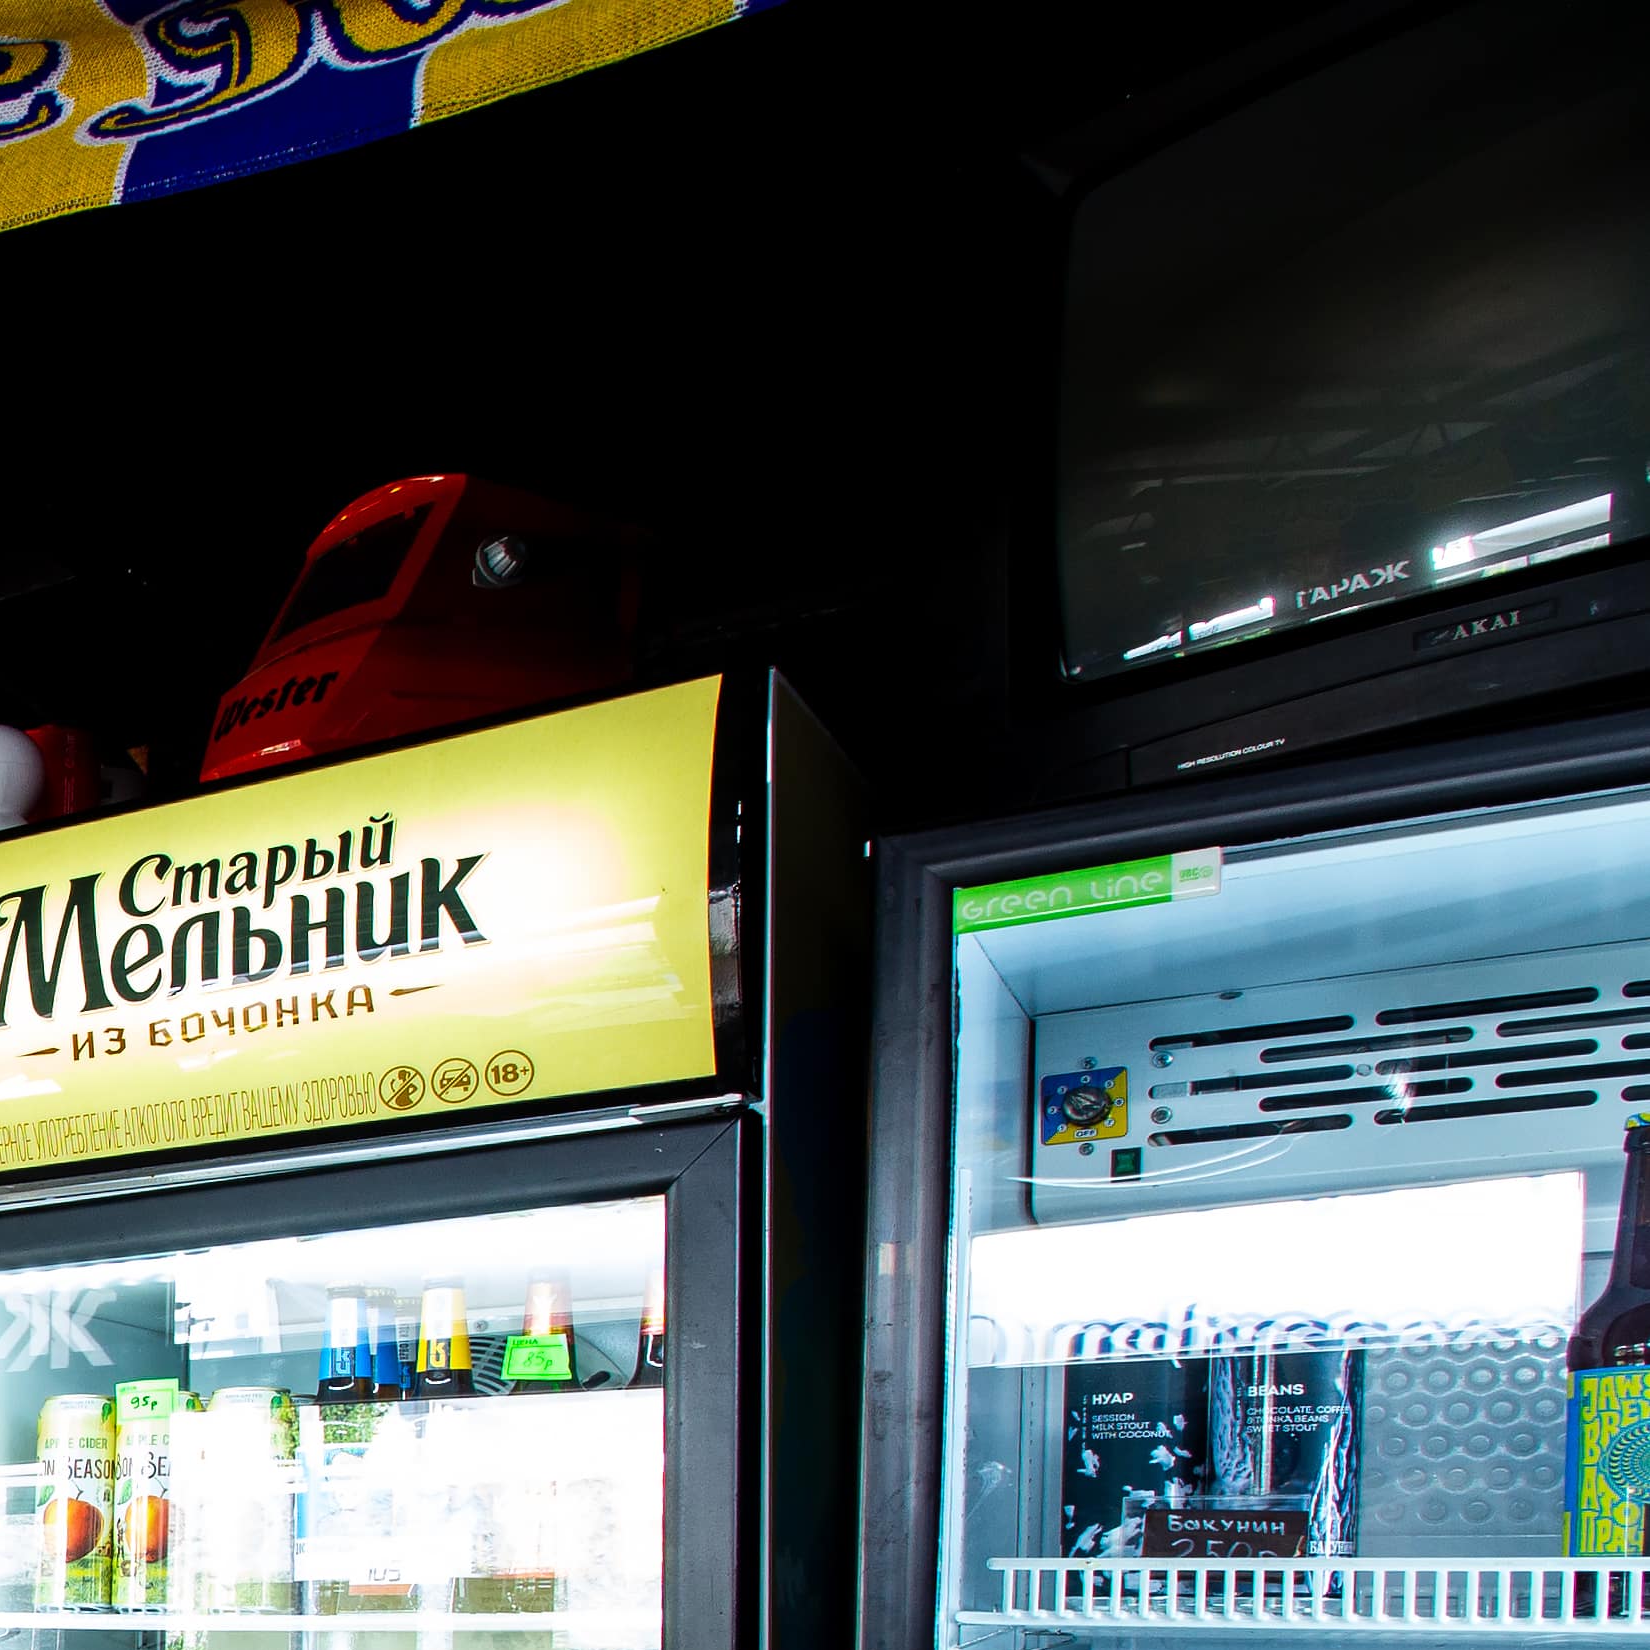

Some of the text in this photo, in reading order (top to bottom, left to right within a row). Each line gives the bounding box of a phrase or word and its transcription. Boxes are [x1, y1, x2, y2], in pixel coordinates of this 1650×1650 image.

[1451, 609, 1521, 640] AKAI
[213, 665, 340, 744] Wester
[1196, 748, 1242, 766] RESOLUTION
[1242, 740, 1274, 755] COLOUR
[1274, 738, 1286, 746] TV
[119, 811, 398, 920] Старый
[961, 885, 1072, 921] Green
[71, 983, 376, 1064] ИЗ БОЧОНКА
[490, 1062, 531, 1087] 18+
[32, 1106, 121, 1160] УПОТРЕБЛЕНИЕ
[121, 1096, 189, 1148] АЛКОГОЛЯ
[190, 1089, 240, 1138] ВРЕДИТ
[241, 1081, 301, 1131] ВАШЕМУ
[302, 1071, 378, 1124] ЗДОРОВЬЮ
[1247, 1383, 1305, 1398] BEANS
[1091, 1412, 1135, 1423] SESSION
[1091, 1420, 1150, 1431] MILK STOUT
[1282, 1422, 1318, 1433] STOUT
[1293, 1413, 1330, 1424] BEANS
[78, 1437, 109, 1450] CIDER
[1091, 1430, 1172, 1441] WITH COCONUT
